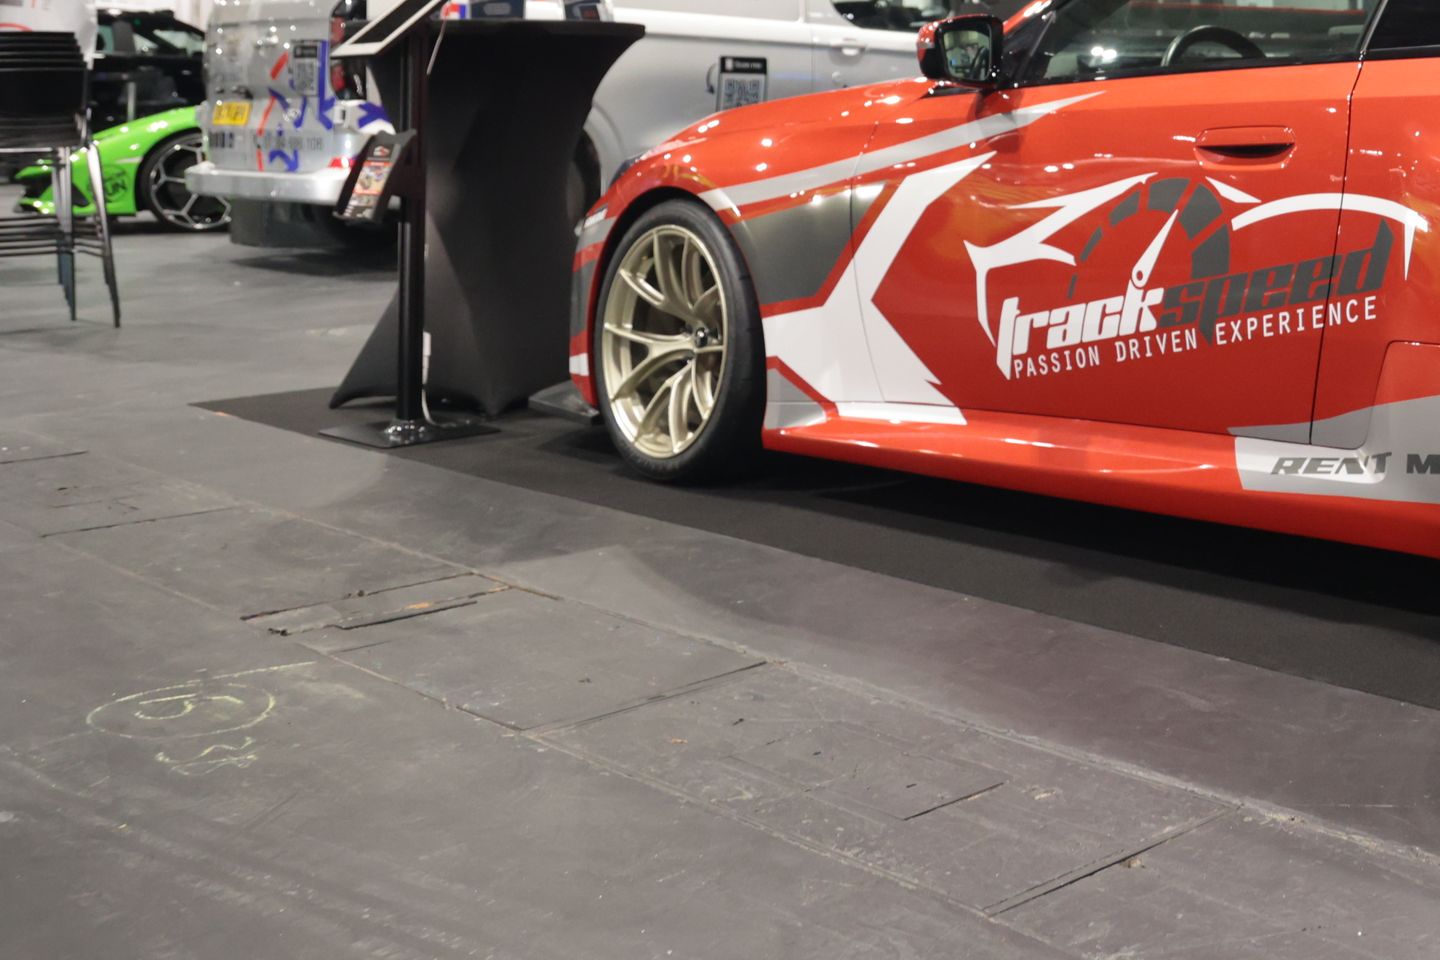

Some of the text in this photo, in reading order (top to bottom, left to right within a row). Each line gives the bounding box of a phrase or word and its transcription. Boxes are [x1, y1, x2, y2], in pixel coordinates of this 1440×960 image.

[1014, 295, 1377, 379] PASSION DRIVEN EXPERIENCE
[1271, 451, 1393, 475] RENT
